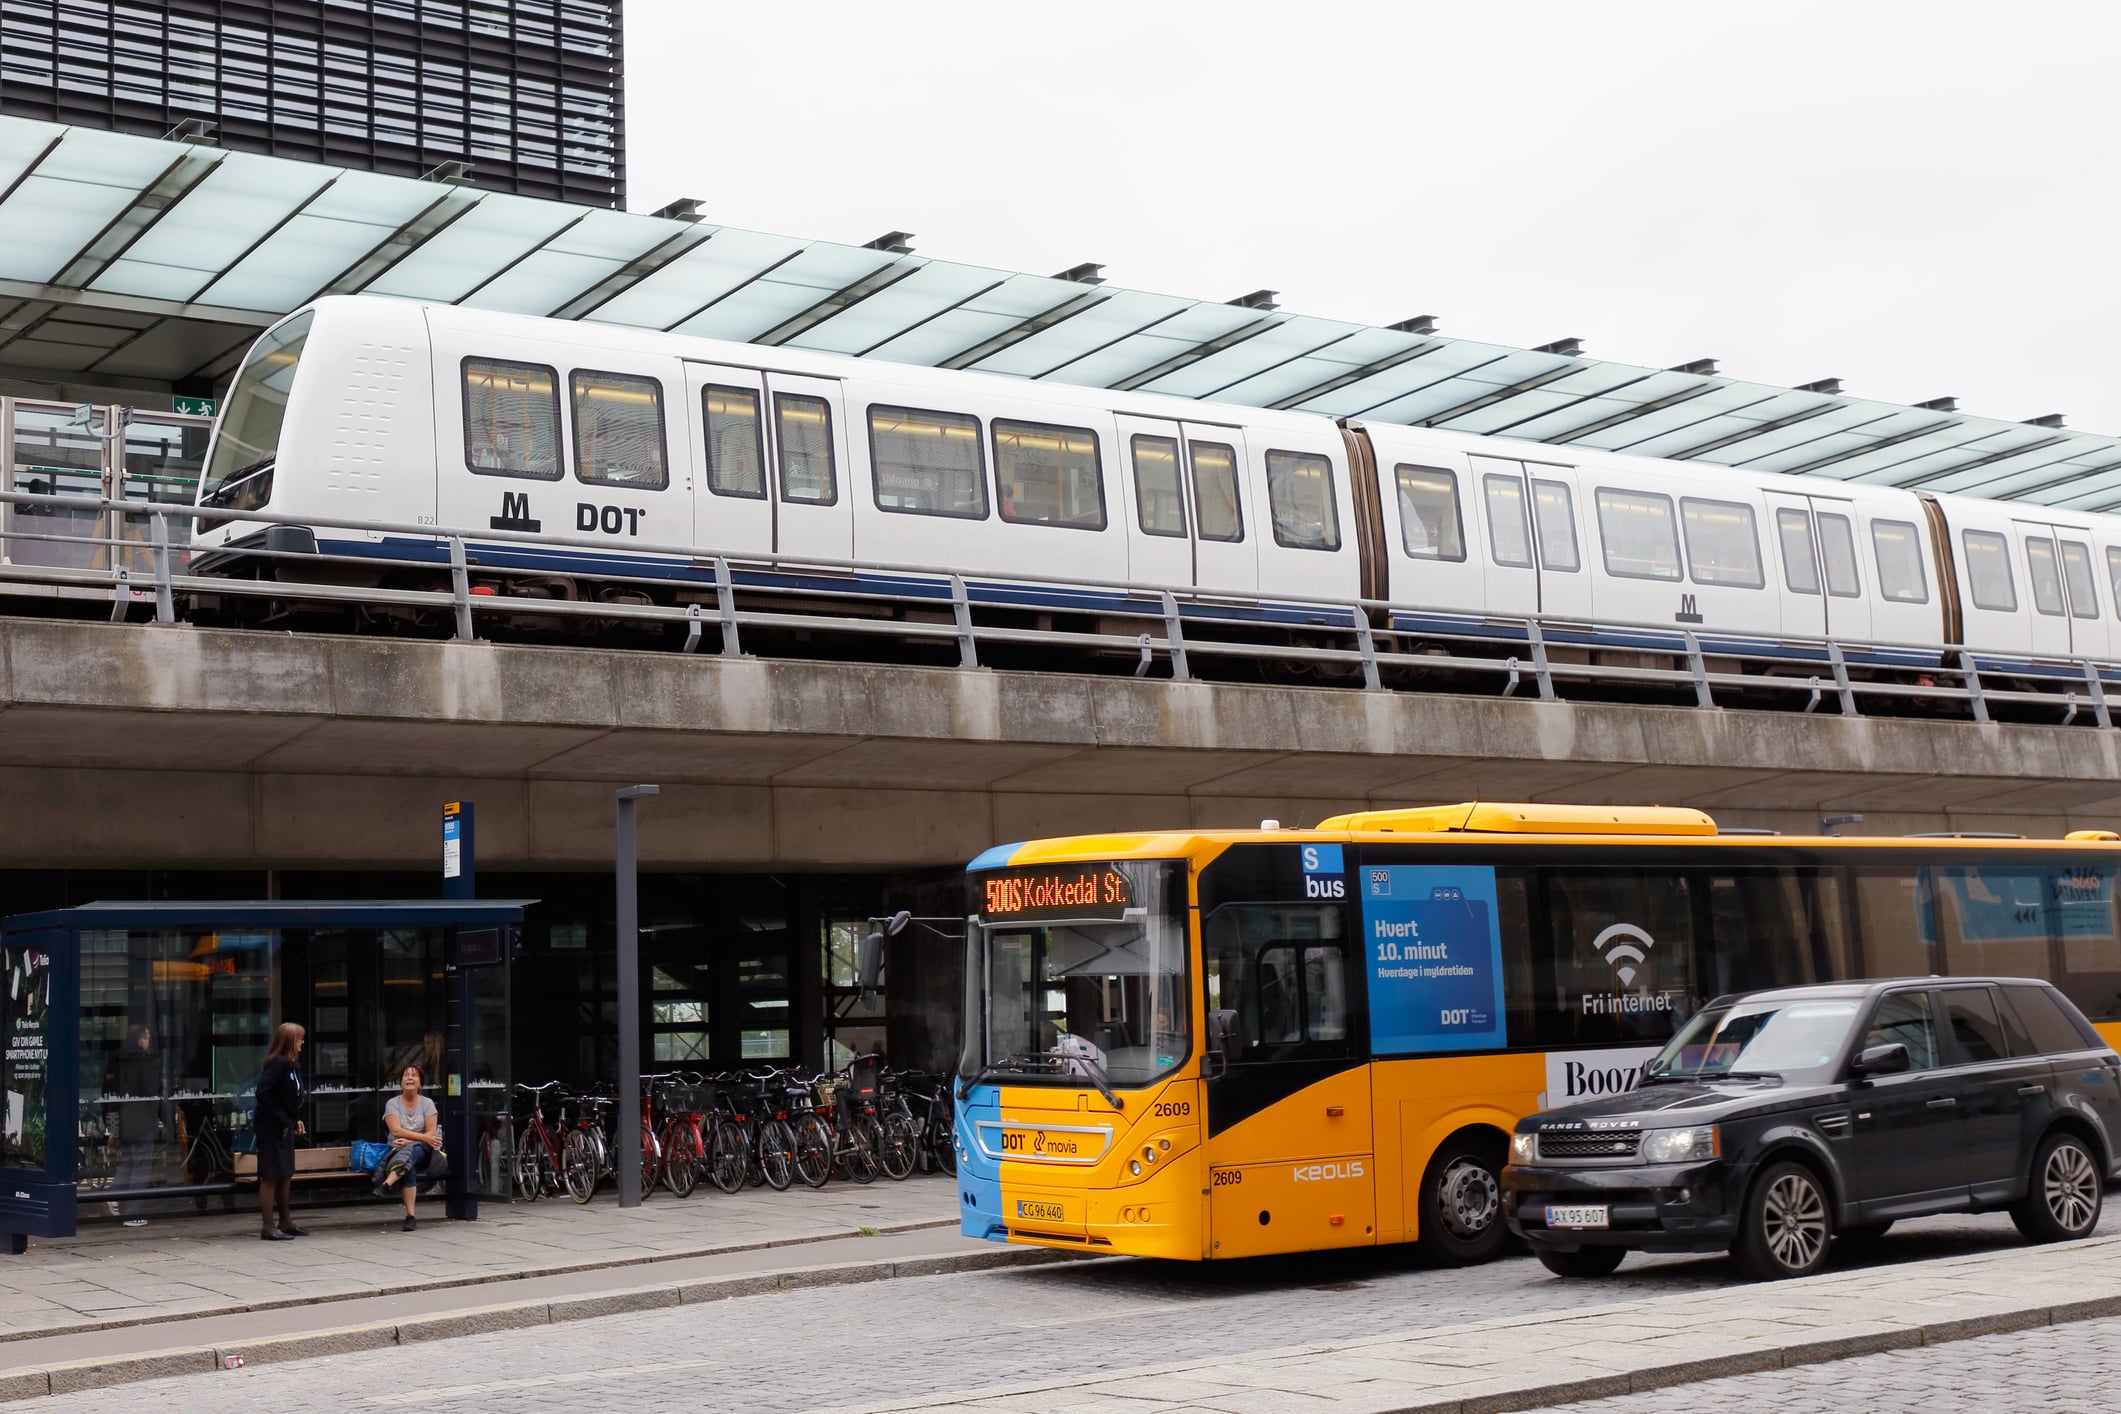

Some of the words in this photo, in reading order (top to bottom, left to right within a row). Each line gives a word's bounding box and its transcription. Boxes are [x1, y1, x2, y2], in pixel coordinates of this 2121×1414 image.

[577, 503, 646, 536] DOT
[1303, 847, 1319, 871] S
[1371, 872, 1388, 882] 500
[986, 878, 1022, 912] 500S
[1024, 874, 1098, 907] Kokkedal
[1104, 872, 1127, 903] St.
[1305, 875, 1345, 898] bus
[1372, 883, 1380, 894] S
[1375, 920, 1418, 938] Hvert
[1377, 942, 1402, 961] 10.
[1404, 941, 1448, 960] minut
[1378, 966, 1418, 979] Hverdage
[1419, 965, 1423, 977] i
[1424, 964, 1474, 978] myldretiden
[1582, 993, 1604, 1015] Fri
[1607, 991, 1672, 1014] internet
[1441, 1008, 1469, 1025] DOT
[1154, 1101, 1190, 1117] 2609
[1589, 1120, 1640, 1129] ROVER
[1002, 1133, 1025, 1150] DOT
[1047, 1139, 1077, 1154] movia
[1213, 1170, 1242, 1186] 2609
[1022, 1203, 1034, 1217] CG
[1035, 1204, 1044, 1217] 96
[1046, 1205, 1063, 1219] 440
[1554, 1209, 1568, 1223] AX
[1569, 1209, 1582, 1223] 95
[1585, 1209, 1604, 1223] 607
